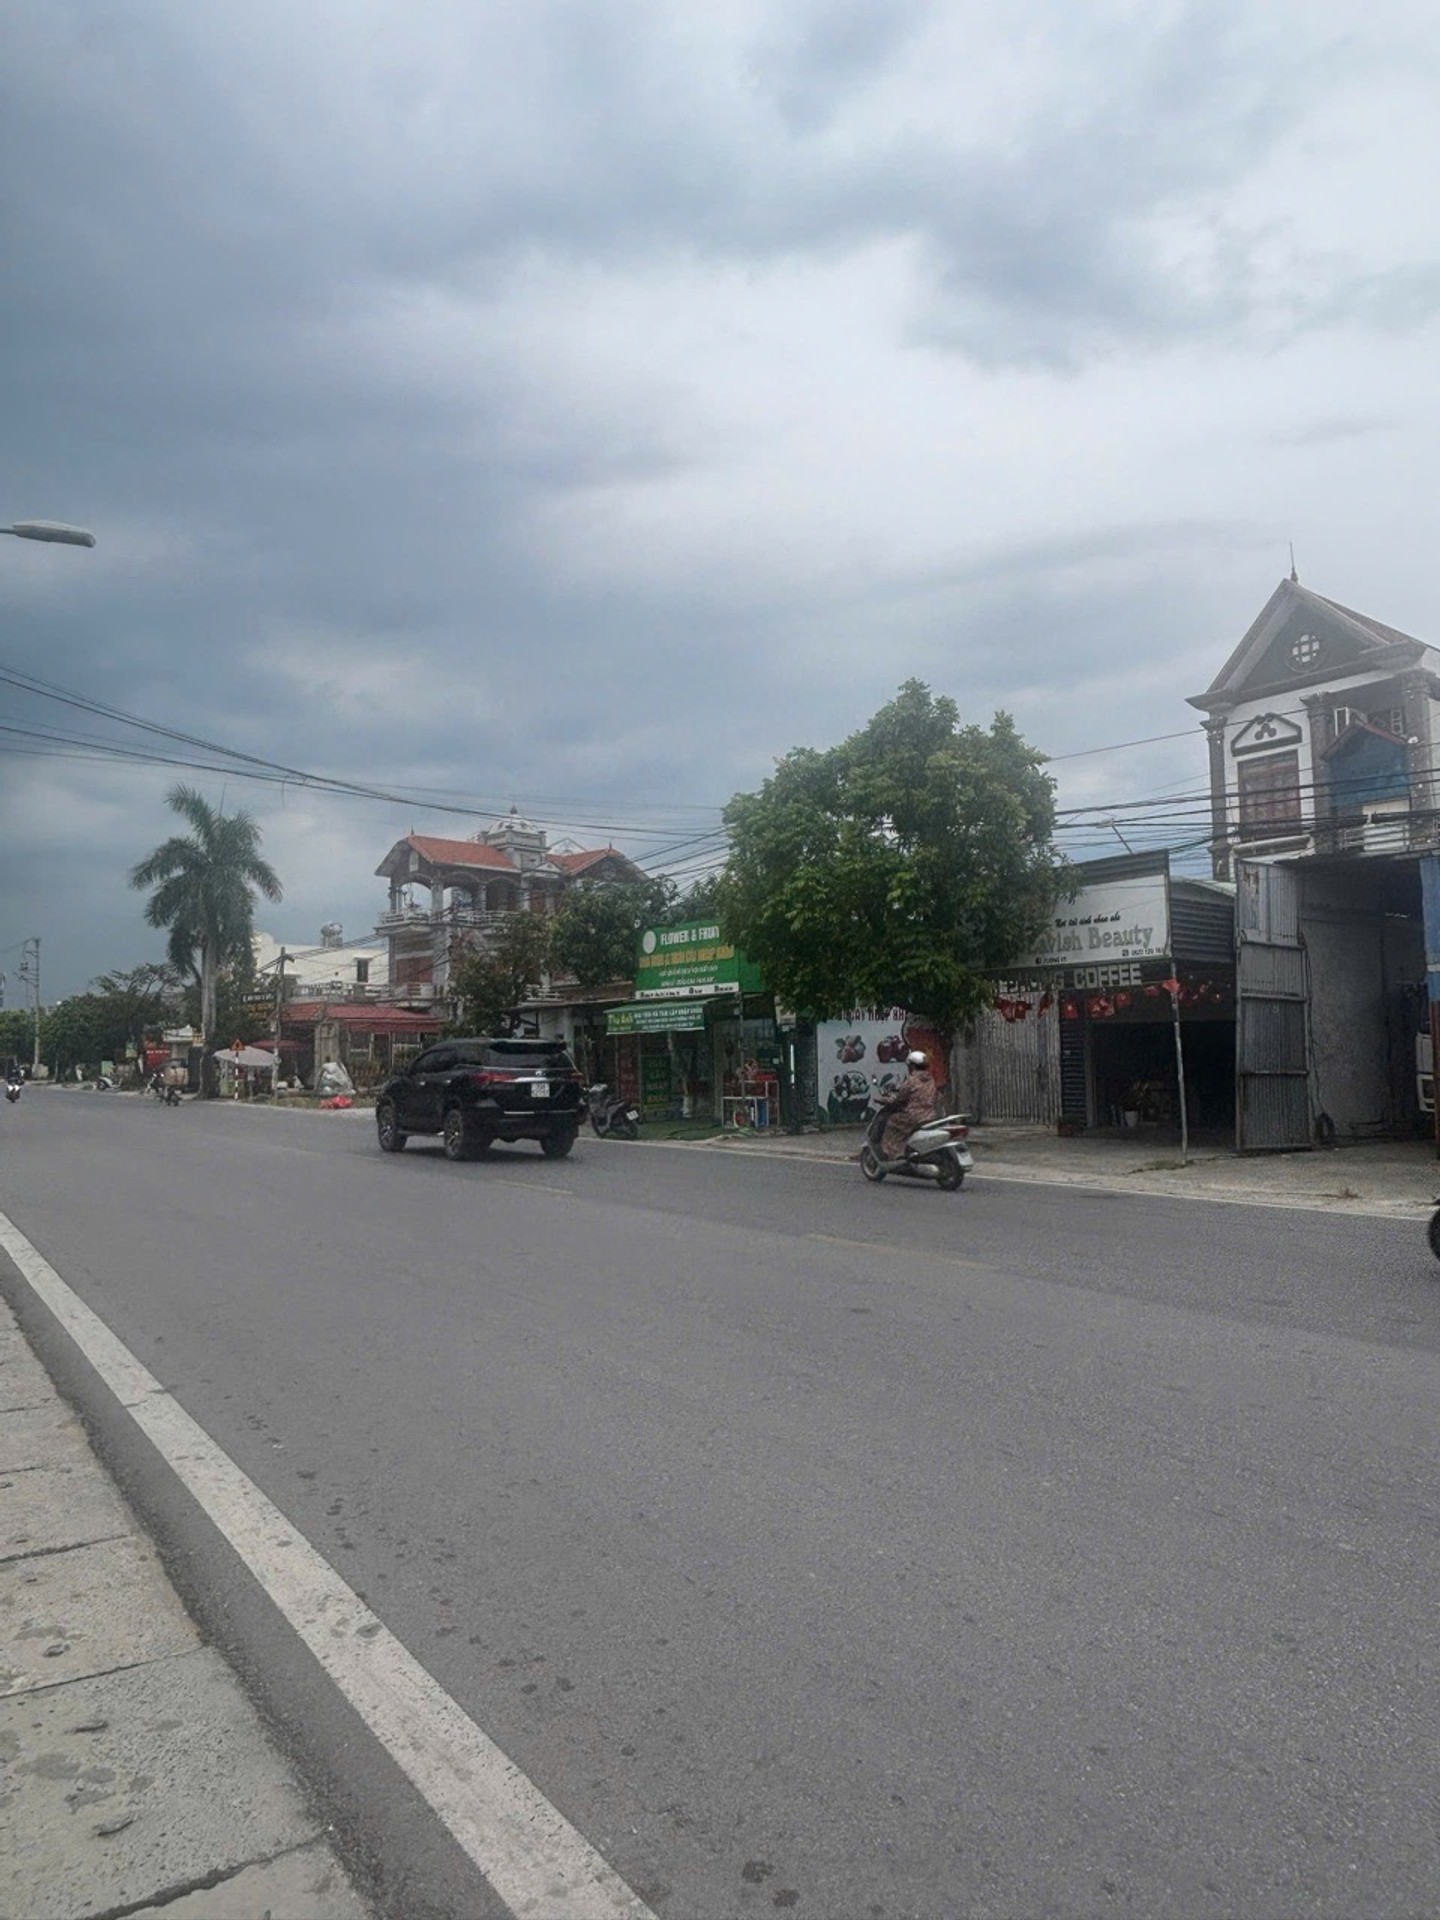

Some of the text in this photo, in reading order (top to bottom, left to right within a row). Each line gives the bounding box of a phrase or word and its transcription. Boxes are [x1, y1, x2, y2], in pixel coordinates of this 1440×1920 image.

[661, 930, 689, 946] FLOWER
[1088, 923, 1153, 950] Beauty
[1074, 963, 1141, 990] COFFEE
